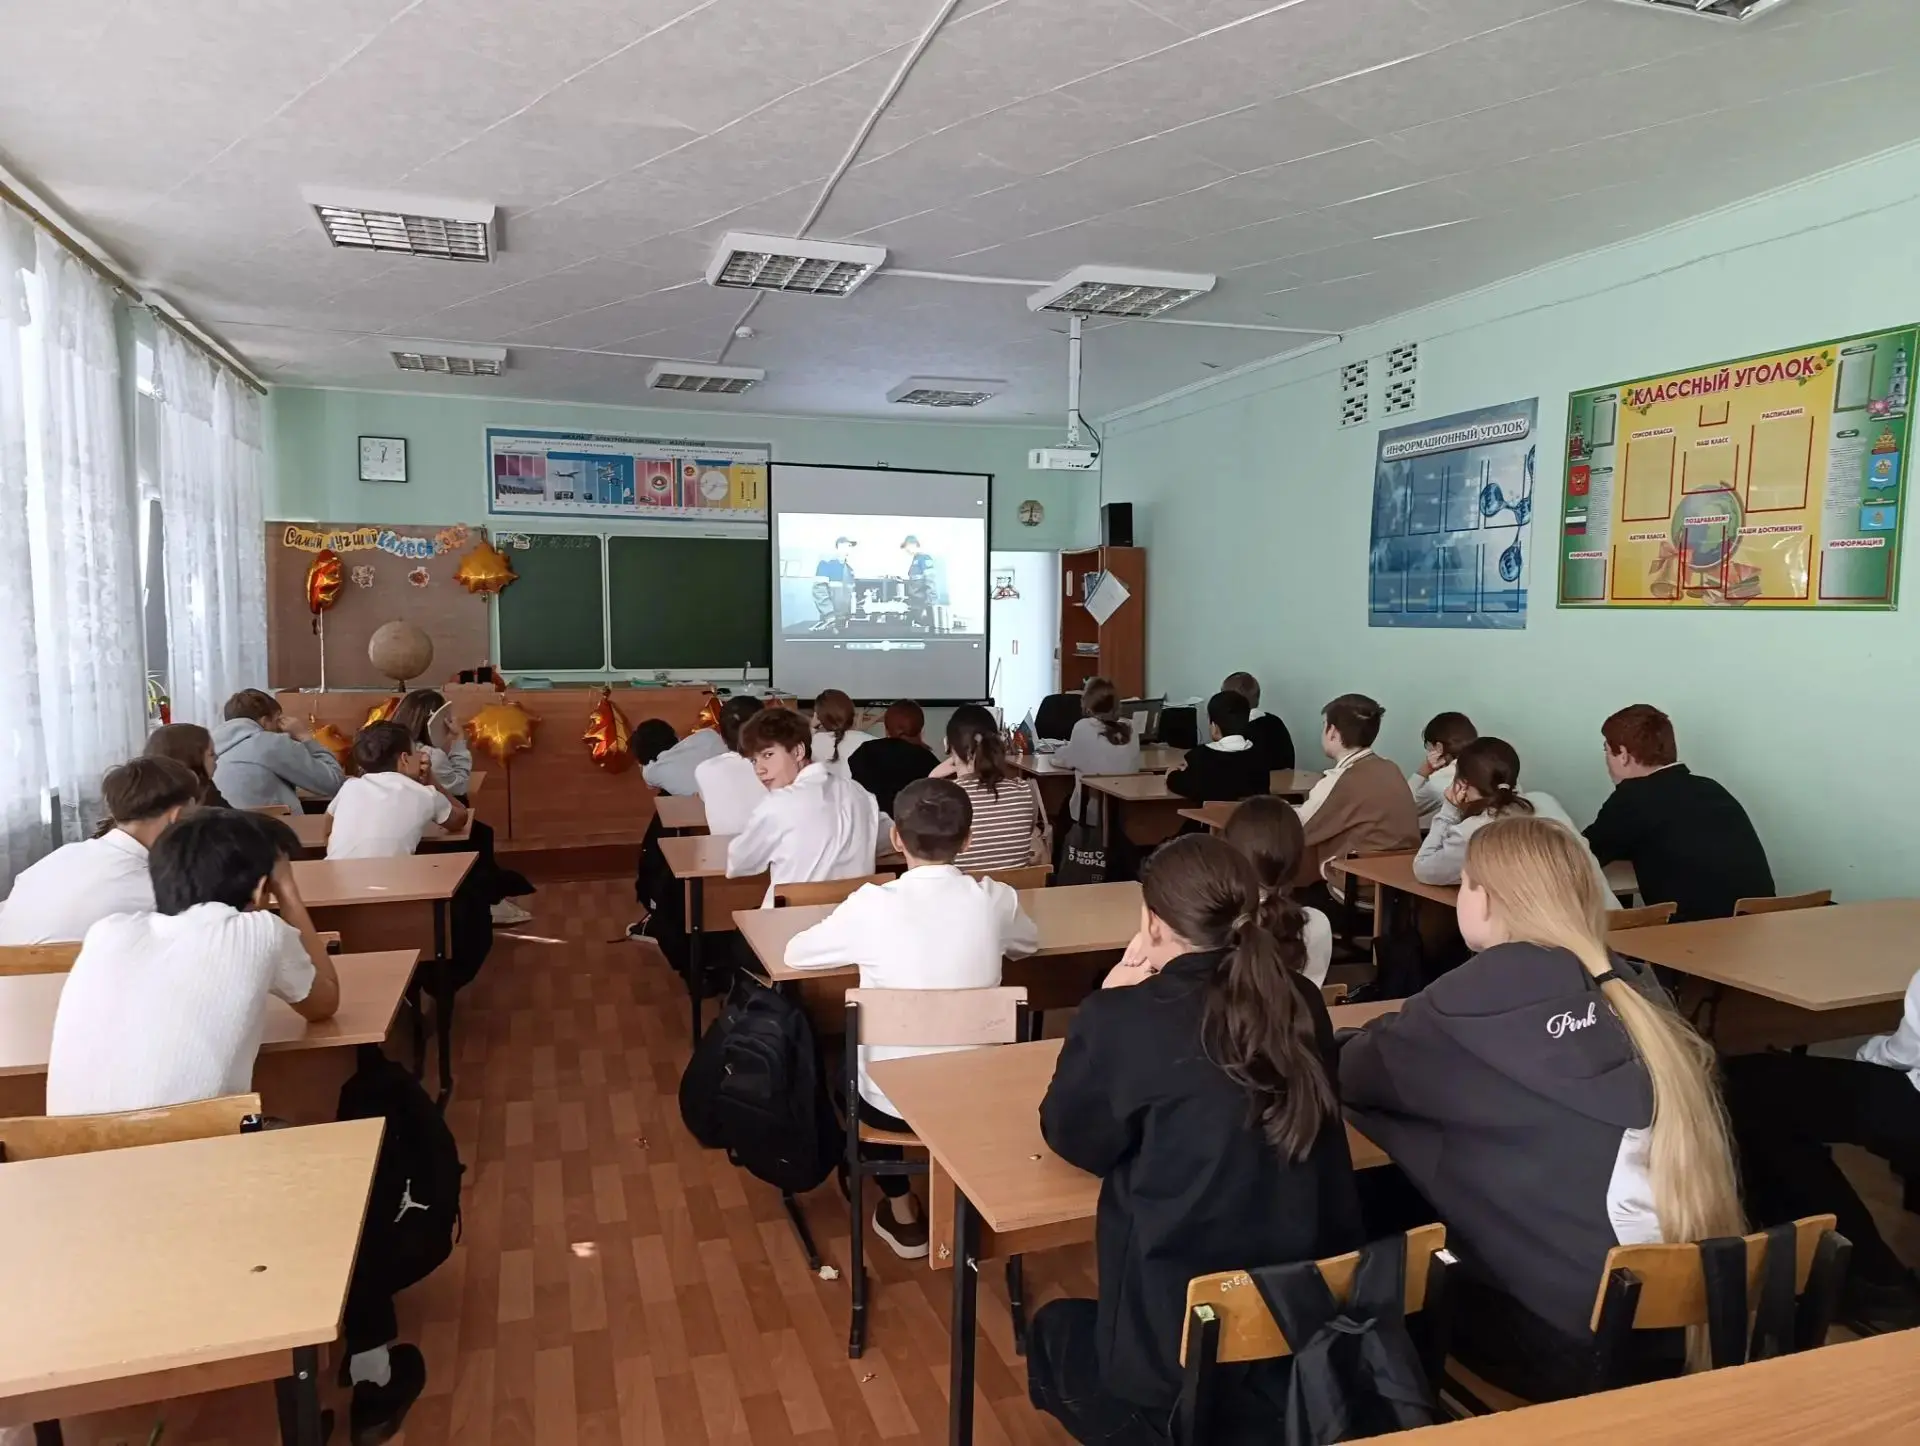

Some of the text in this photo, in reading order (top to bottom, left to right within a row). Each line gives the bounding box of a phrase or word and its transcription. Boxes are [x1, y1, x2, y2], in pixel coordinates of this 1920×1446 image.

[1634, 355, 1815, 406] КЛАССНЫЙ УГОЛОК
[1761, 408, 1803, 419] РАСПИСАНИЕ
[1653, 427, 1673, 436] КЛАССА
[1386, 419, 1526, 456] ИНФОРМАЦИОННЫЙ УГОЛОК
[1710, 437, 1729, 445] КЛАСС
[1738, 524, 1803, 534] НАШИ ДОСТИЖЕНИЯ
[1829, 539, 1884, 548] ИНФОРМАЦИЯ
[1546, 1001, 1597, 1039] Pink
